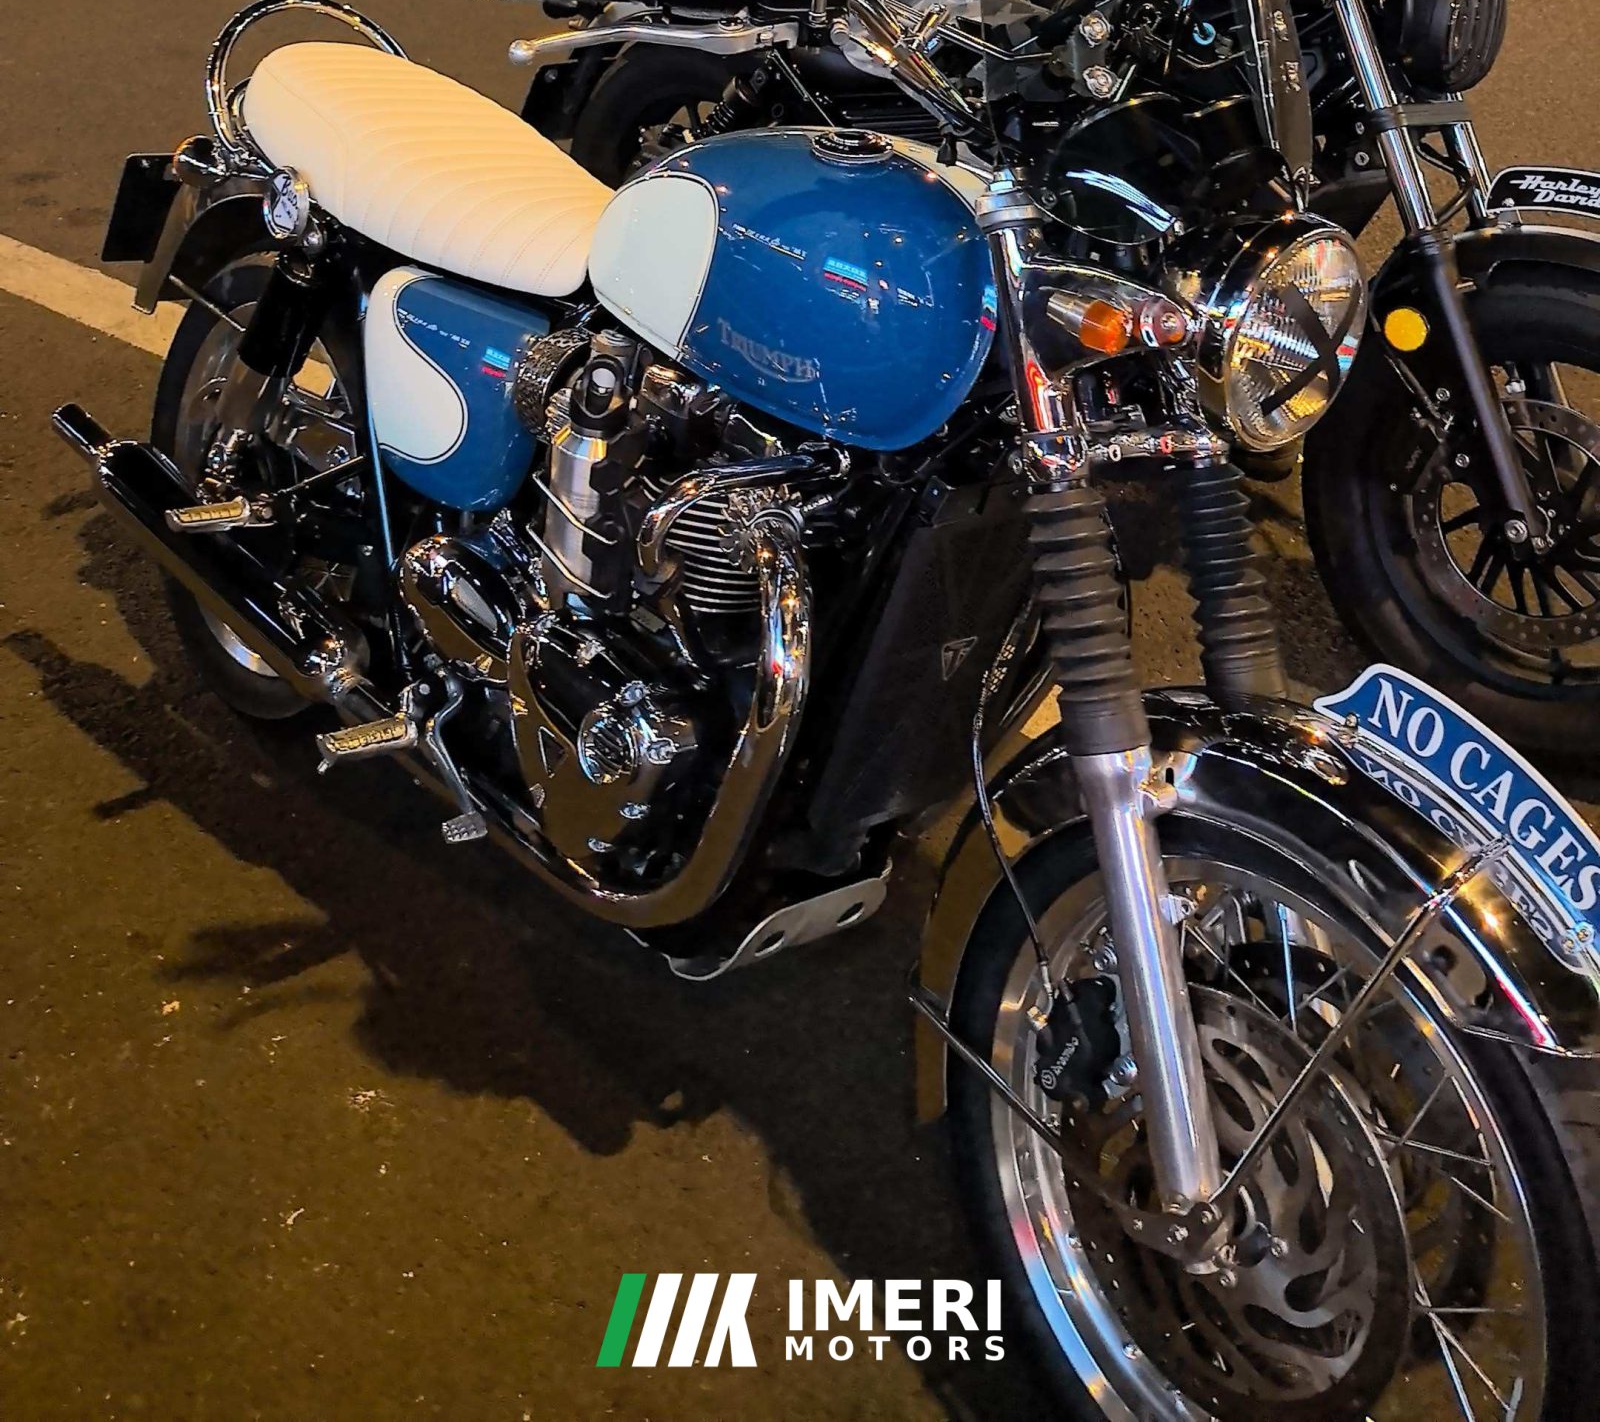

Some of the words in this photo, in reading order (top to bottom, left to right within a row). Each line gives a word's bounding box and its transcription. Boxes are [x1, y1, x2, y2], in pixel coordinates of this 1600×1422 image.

[717, 317, 817, 380] TRIUMPH
[1368, 678, 1444, 757] NO
[1450, 741, 1600, 911] CAGES
